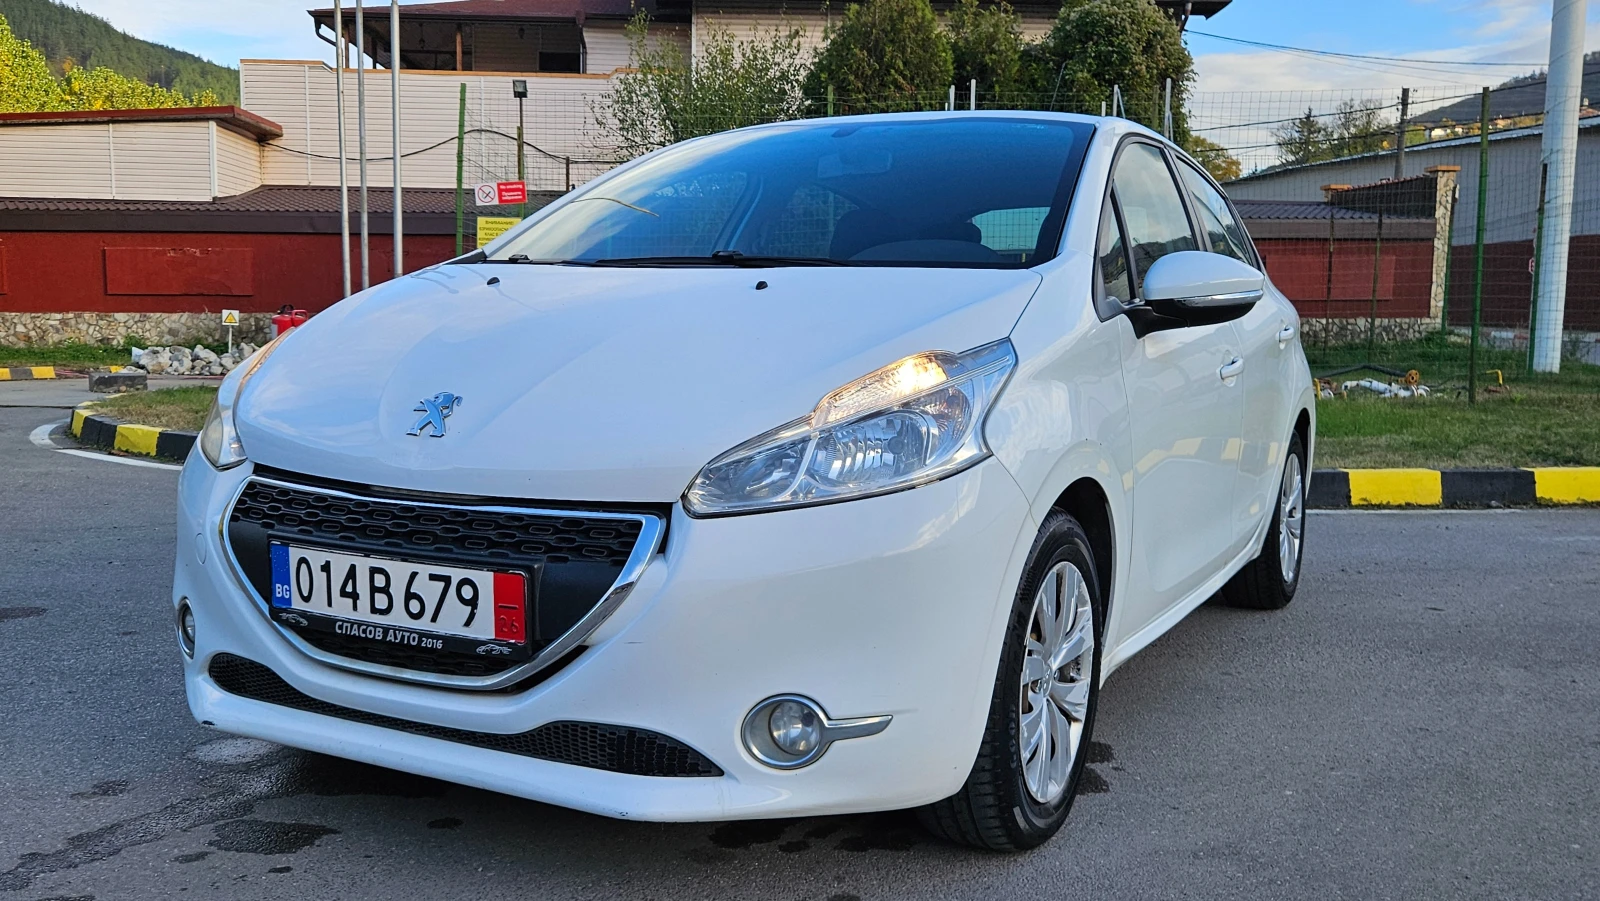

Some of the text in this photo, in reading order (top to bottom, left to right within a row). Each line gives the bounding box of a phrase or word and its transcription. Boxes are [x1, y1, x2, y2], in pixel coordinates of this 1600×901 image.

[275, 583, 290, 599] BG
[335, 621, 443, 650] СПАСОВ АУТО 2016
